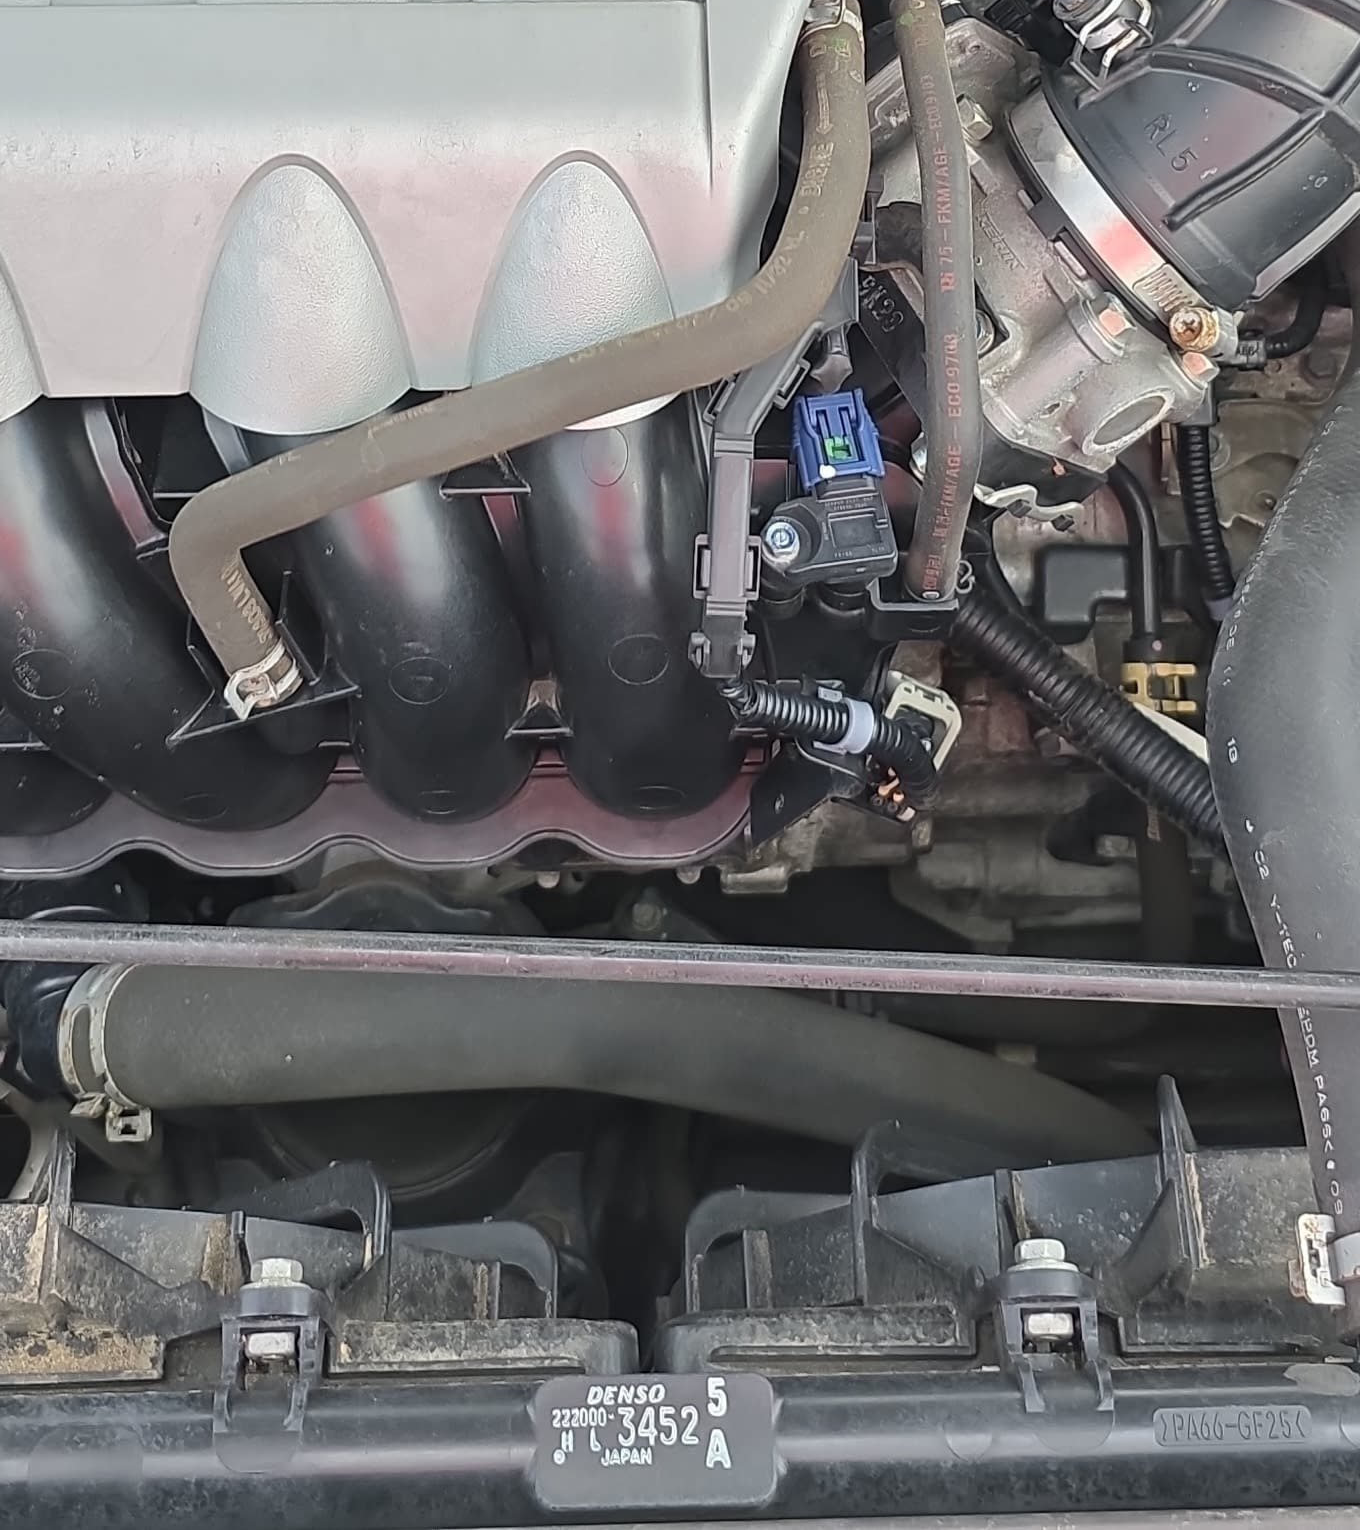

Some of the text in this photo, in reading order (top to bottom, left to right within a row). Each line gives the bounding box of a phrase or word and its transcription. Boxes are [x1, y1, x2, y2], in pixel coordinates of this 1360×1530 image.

[586, 1383, 667, 1406] DENSO
[706, 1376, 728, 1417] 5
[600, 1446, 654, 1467] JAPAN
[705, 1428, 732, 1470] A
